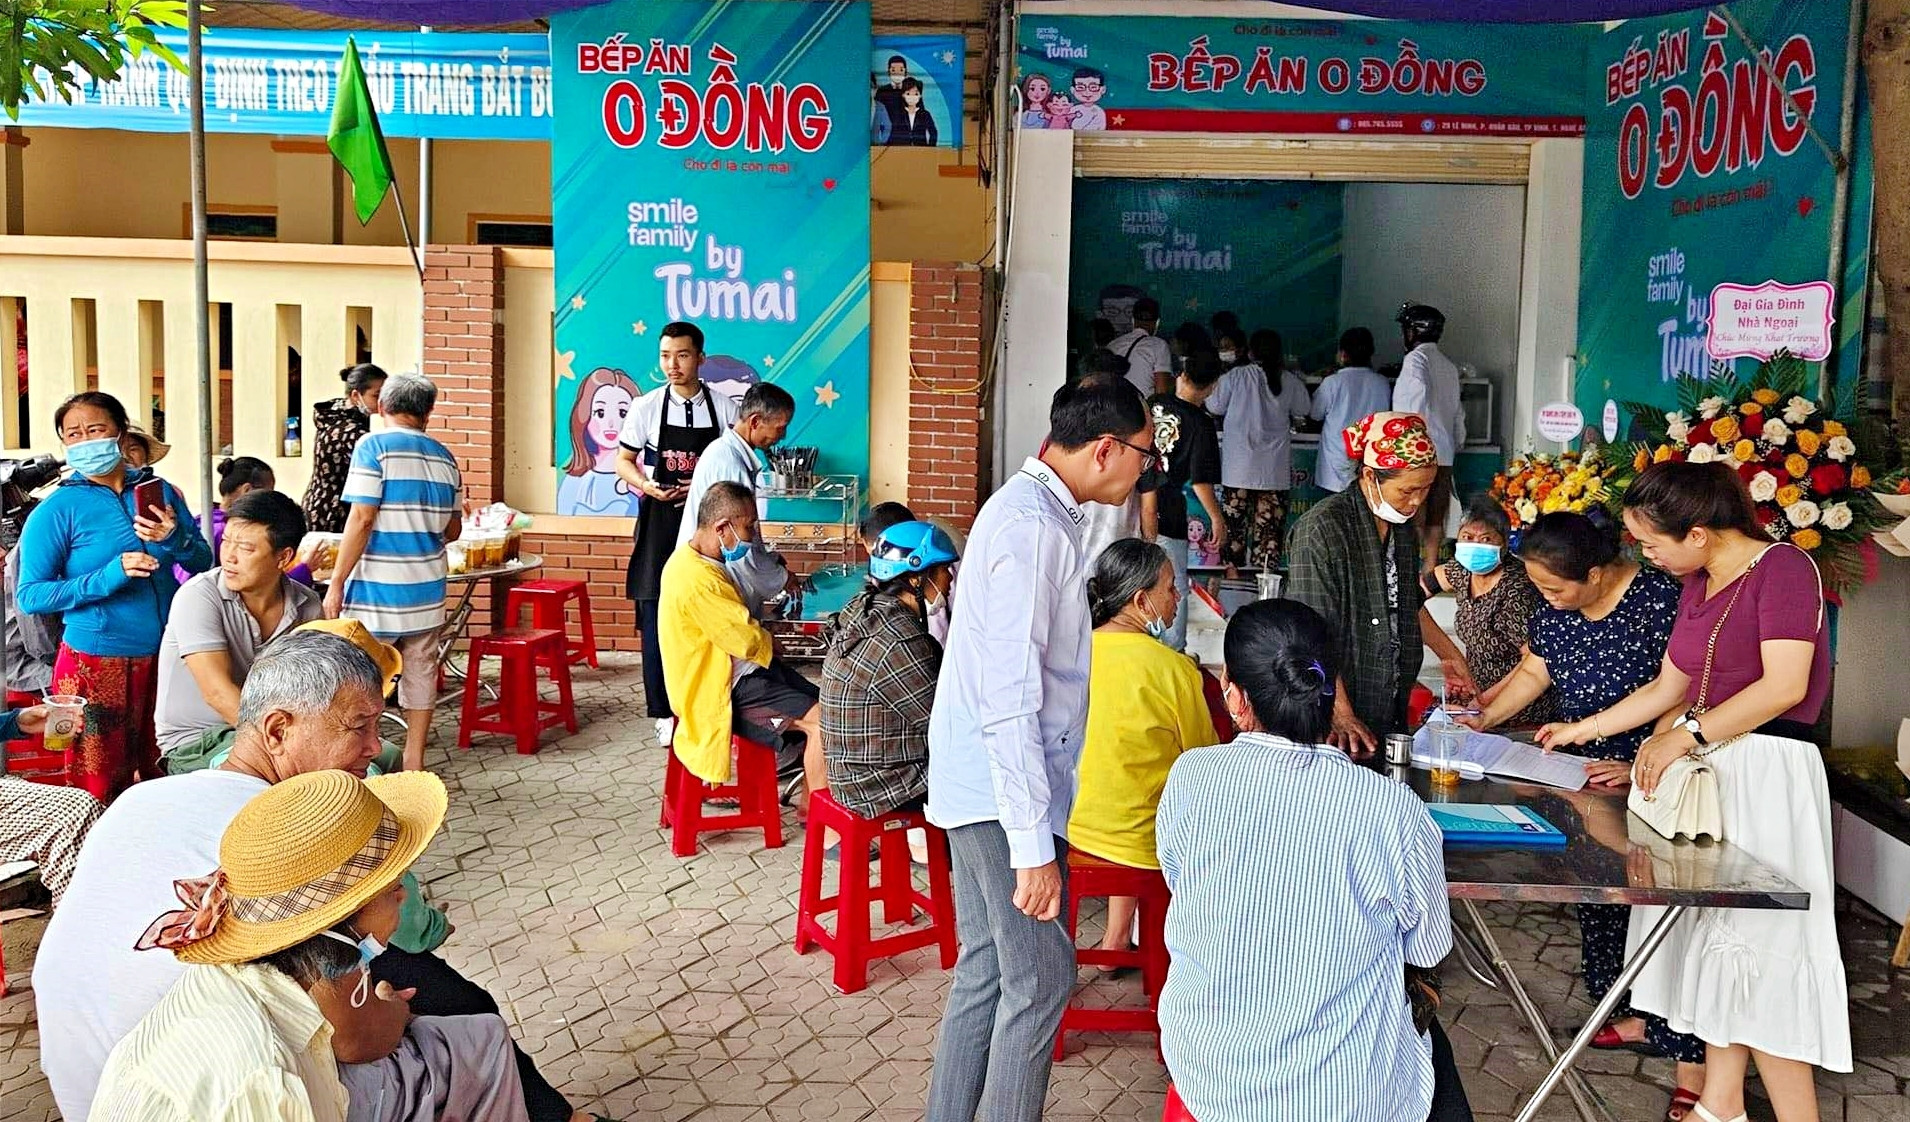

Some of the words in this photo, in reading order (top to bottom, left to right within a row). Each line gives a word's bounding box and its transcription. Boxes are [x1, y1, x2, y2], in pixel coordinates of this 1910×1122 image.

[577, 33, 643, 74] BẾP
[643, 38, 691, 75] ĂN
[1044, 43, 1088, 59] Tumai
[1060, 36, 1071, 48] by
[1148, 35, 1241, 93] BẾP
[1245, 47, 1307, 95] ĂN
[1357, 38, 1486, 97] ĐỒNG
[1606, 35, 1651, 106] BẾP
[1650, 27, 1690, 88] ĂN
[401, 61, 475, 115] TRANG
[656, 42, 831, 155] ĐỒNG
[1655, 11, 1816, 188] ĐỒNG
[627, 198, 698, 224] smile
[1122, 210, 1167, 223] smile
[627, 224, 698, 252] family
[1172, 228, 1198, 249] by
[706, 235, 742, 279] by
[1138, 241, 1233, 272] Tumai
[1648, 247, 1685, 278] smile
[654, 263, 797, 322] Tumai
[1647, 276, 1684, 306] family
[1734, 298, 1752, 313] Đại
[1755, 298, 1773, 310] Gia
[1777, 297, 1805, 310] Đình
[1687, 284, 1707, 331] by
[1738, 316, 1760, 328] Nhà
[1764, 315, 1799, 331] Ngoại
